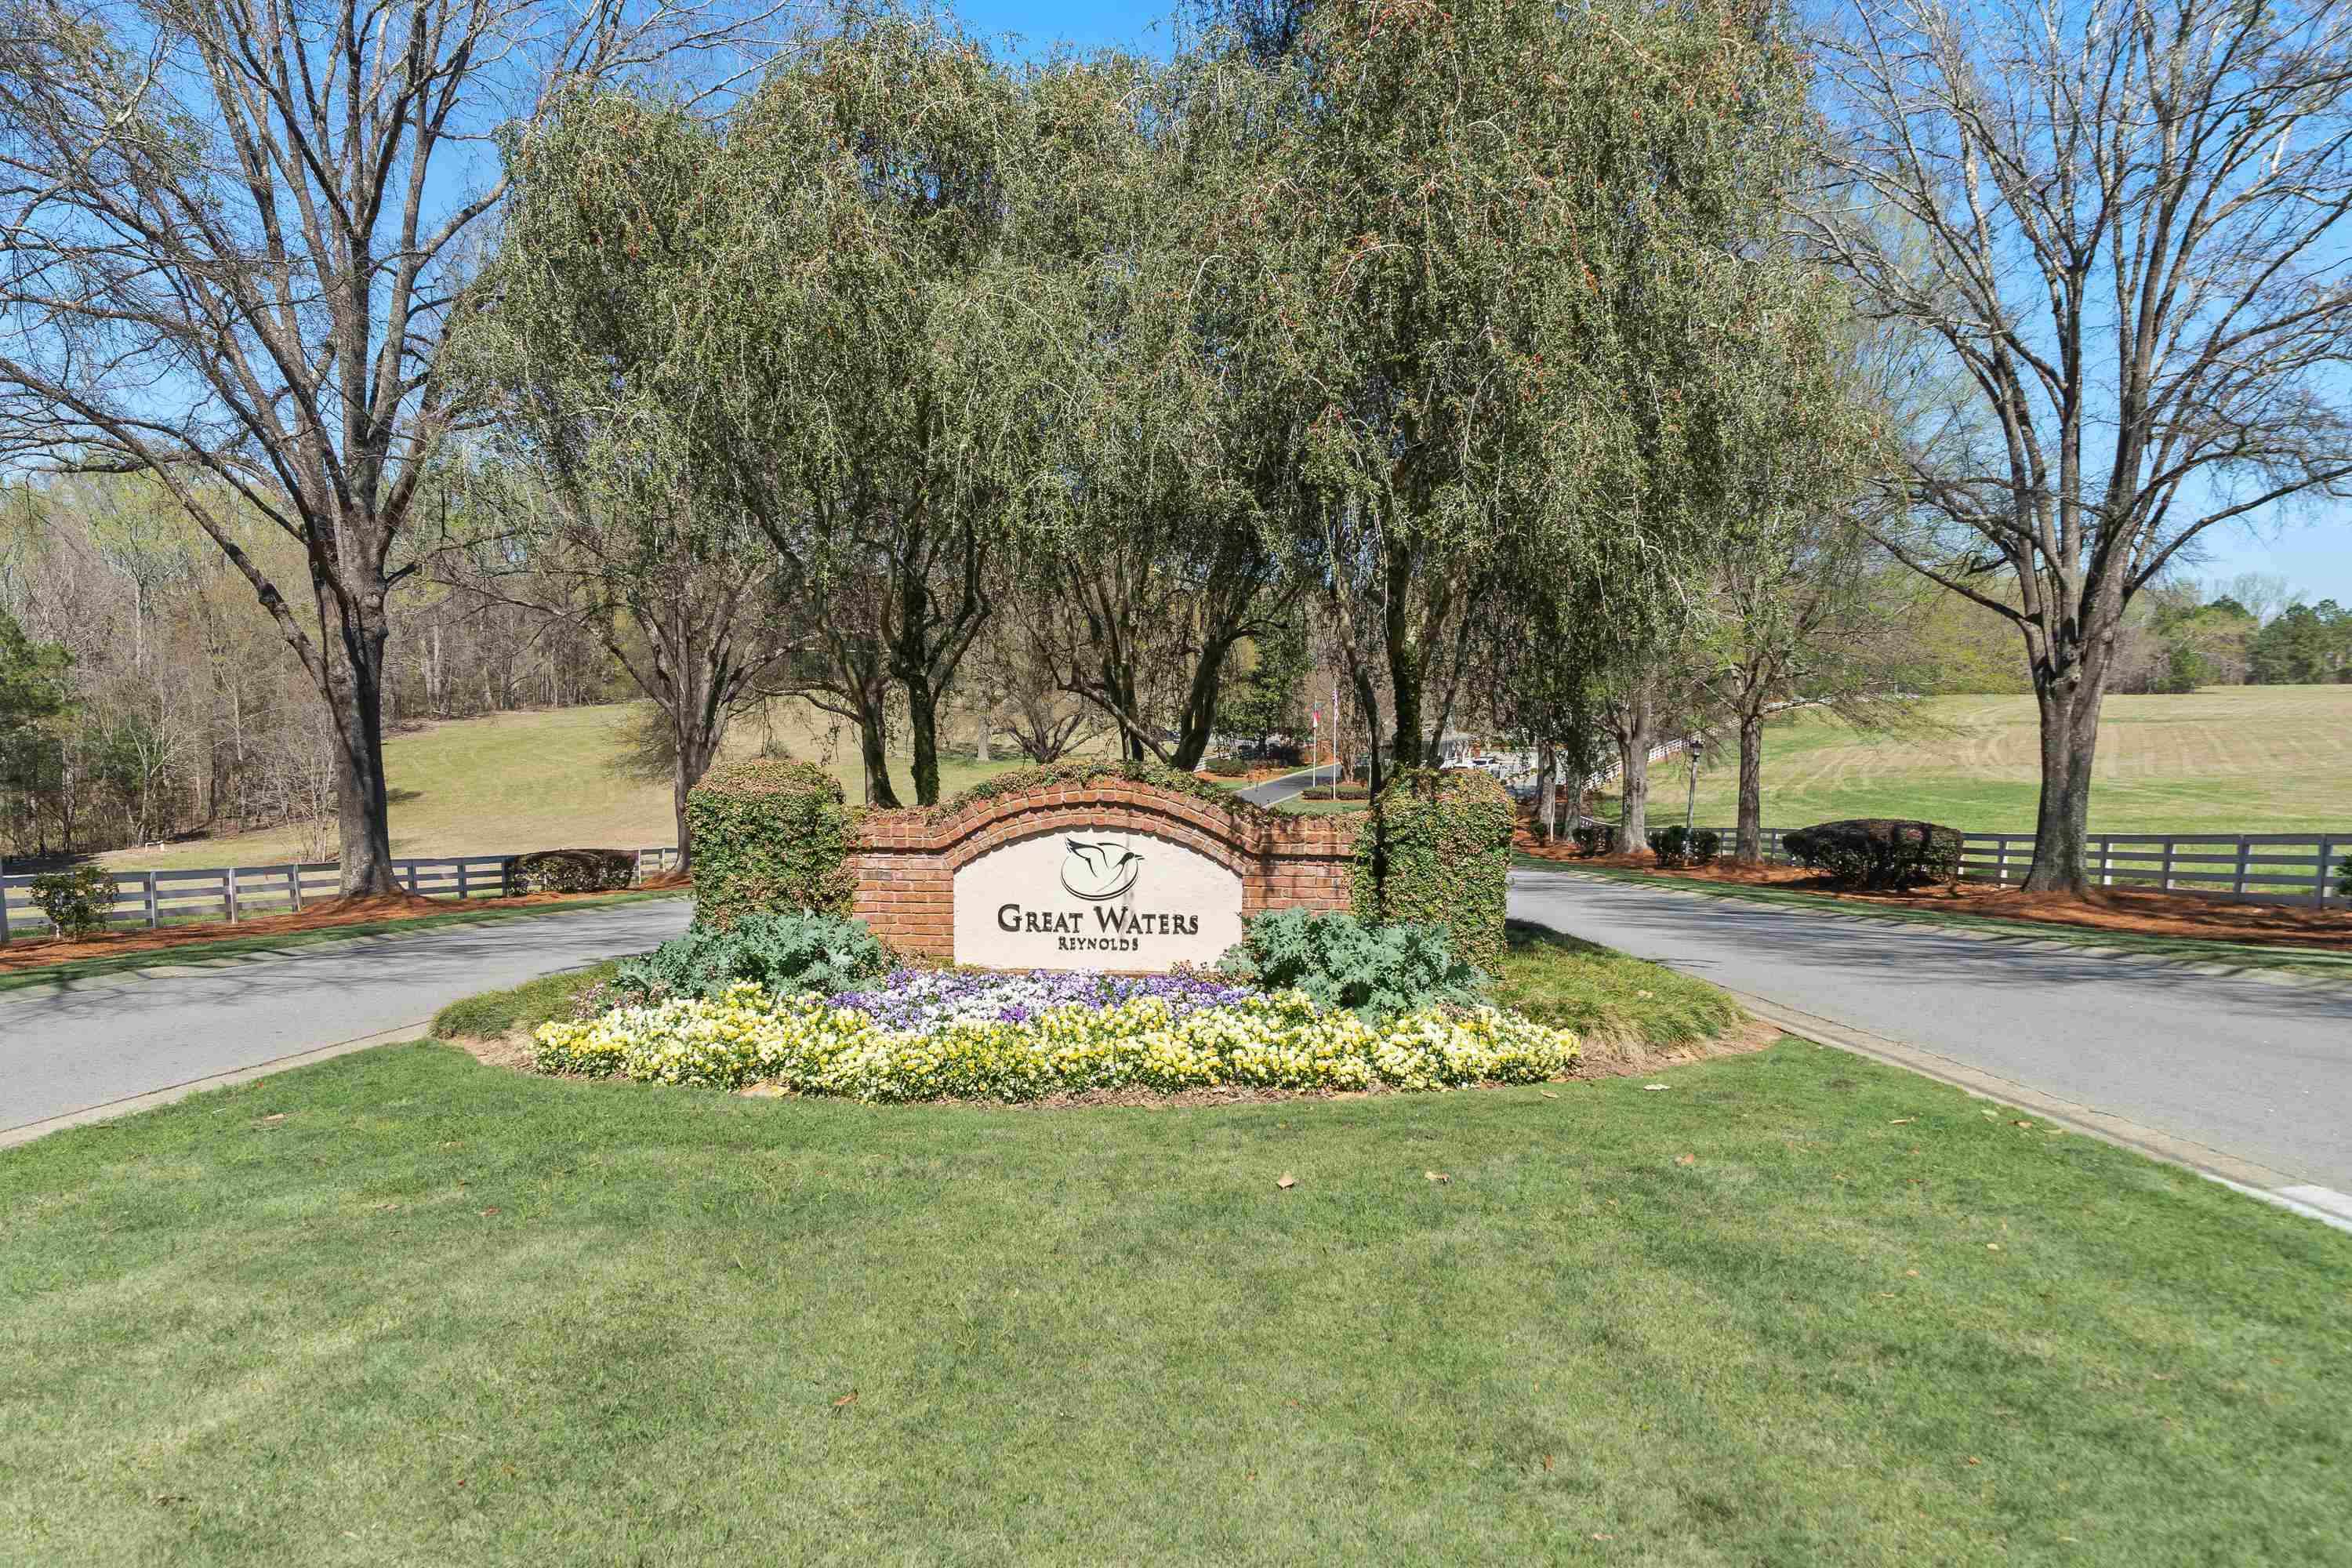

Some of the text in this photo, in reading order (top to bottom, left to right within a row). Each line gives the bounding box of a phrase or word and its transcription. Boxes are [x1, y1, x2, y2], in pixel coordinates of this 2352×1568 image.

[998, 904, 1199, 935] GREAT WATERS
[1058, 936, 1139, 951] REYNOLDS
